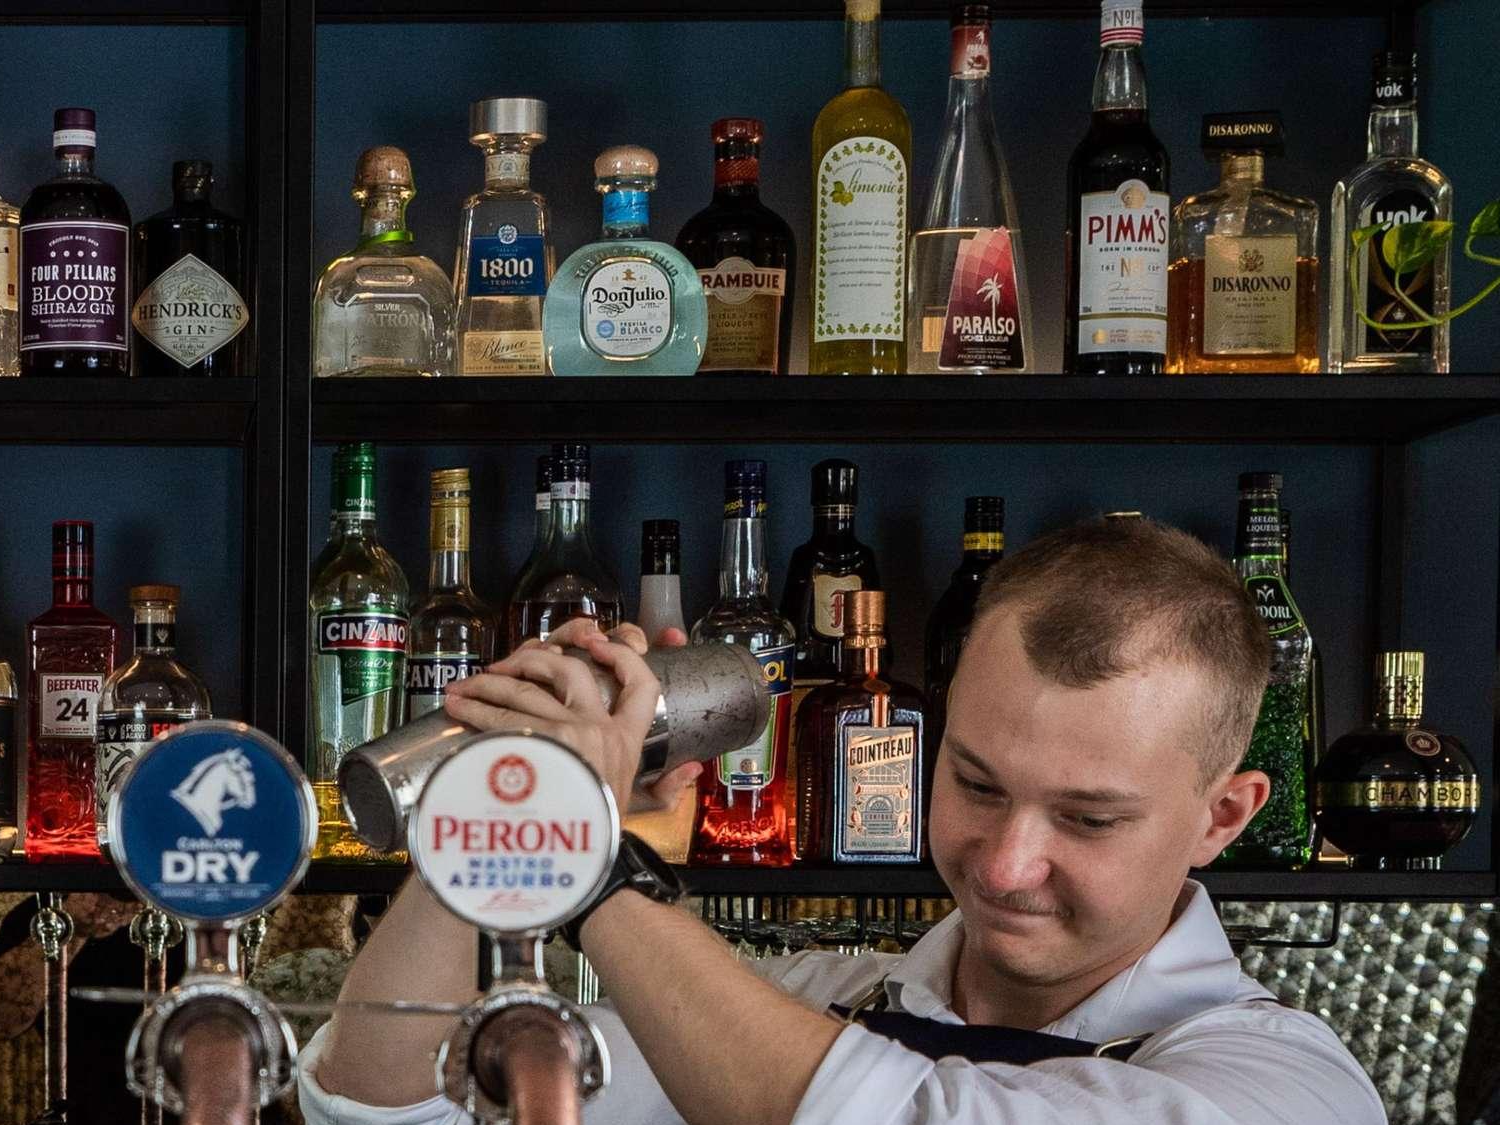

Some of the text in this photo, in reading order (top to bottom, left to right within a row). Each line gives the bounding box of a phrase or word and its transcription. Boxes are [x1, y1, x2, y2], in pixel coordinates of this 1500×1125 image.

[1209, 123, 1273, 137] DISARONNO
[1088, 209, 1167, 245] PIMM'S
[31, 264, 117, 282] FOUR PILLARS
[479, 258, 535, 279] 1800
[31, 284, 117, 303] BLOODY
[1212, 276, 1292, 293] DISARONNO
[31, 302, 116, 316] SHIRAZ GIN
[139, 302, 242, 320] HENDRICK'S
[173, 324, 207, 335] GIN
[619, 325, 663, 336] BLANCO
[325, 619, 407, 644] CINZANO
[46, 678, 100, 694] BEEFEATER
[55, 697, 89, 722] 24
[126, 723, 146, 733] PURO
[850, 737, 914, 765] COINTREAU
[432, 815, 592, 855] PERONI
[160, 851, 261, 884] DRY
[468, 856, 555, 869] NASTRO
[448, 871, 575, 889] AZZURRO
